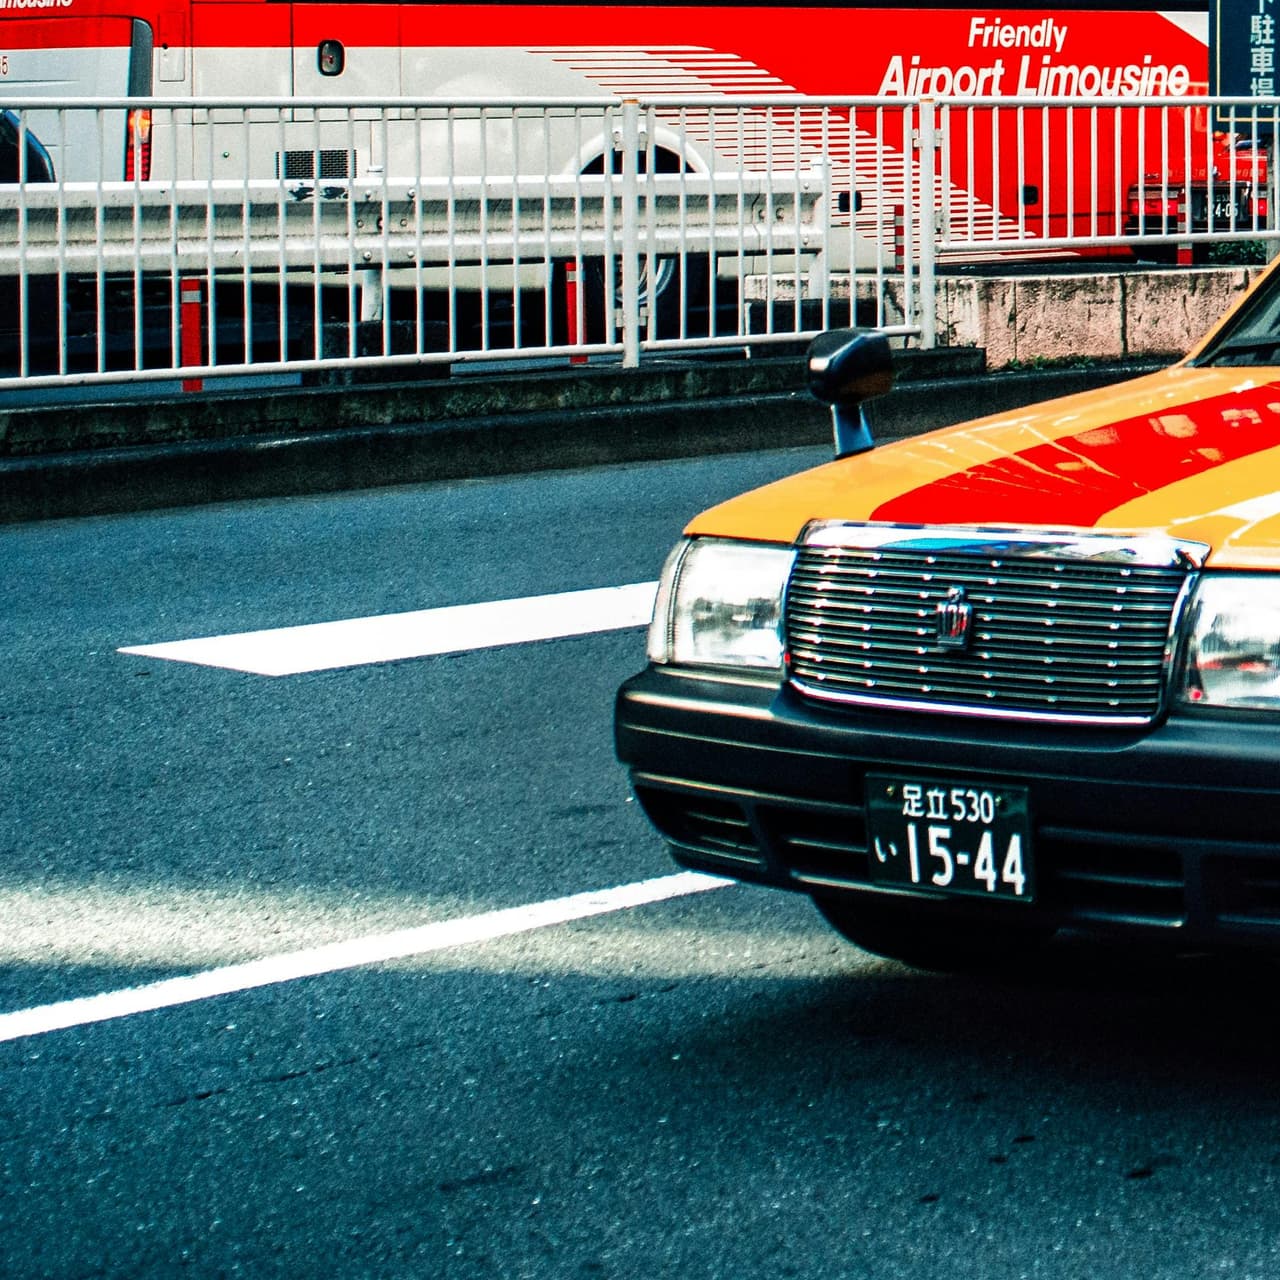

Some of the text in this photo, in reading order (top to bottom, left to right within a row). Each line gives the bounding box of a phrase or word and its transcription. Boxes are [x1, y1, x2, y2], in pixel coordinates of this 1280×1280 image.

[968, 17, 1067, 53] Friendly
[876, 55, 1189, 97] Airport Limousine
[907, 822, 1026, 896] 15-44
